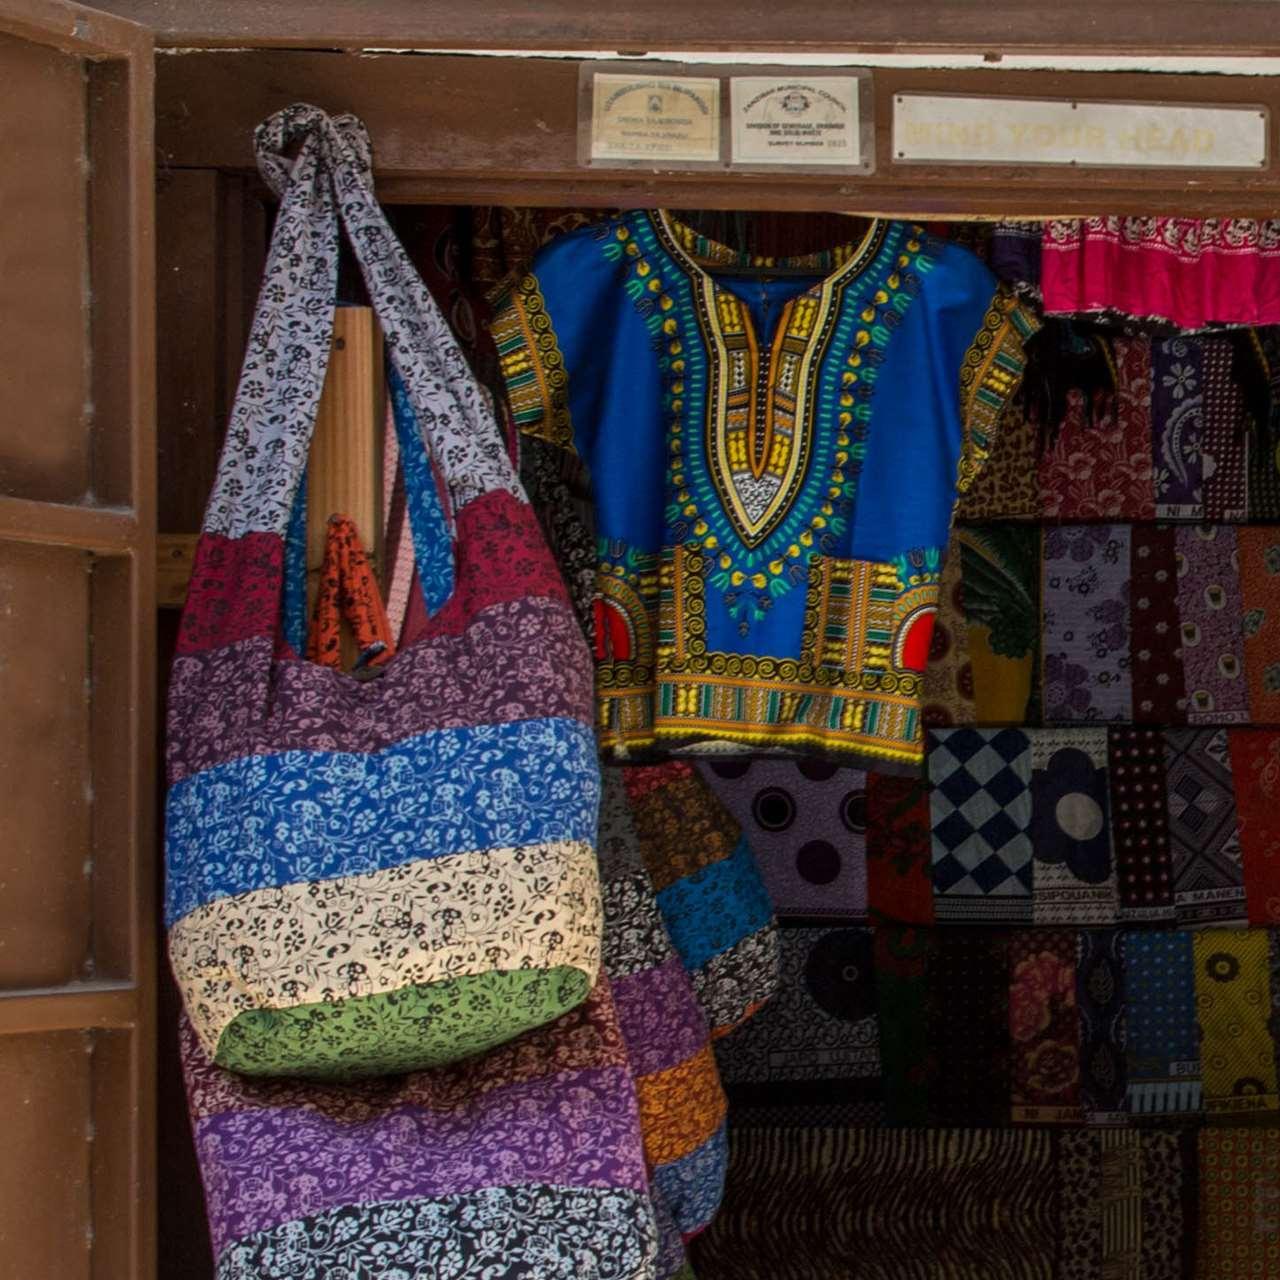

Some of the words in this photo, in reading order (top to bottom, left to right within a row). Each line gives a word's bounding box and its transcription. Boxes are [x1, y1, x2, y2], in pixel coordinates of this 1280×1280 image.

[777, 84, 816, 93] MUNICIPAL
[903, 119, 997, 146] MIND
[1008, 121, 1105, 150] YOUR
[1119, 126, 1217, 154] HEAD
